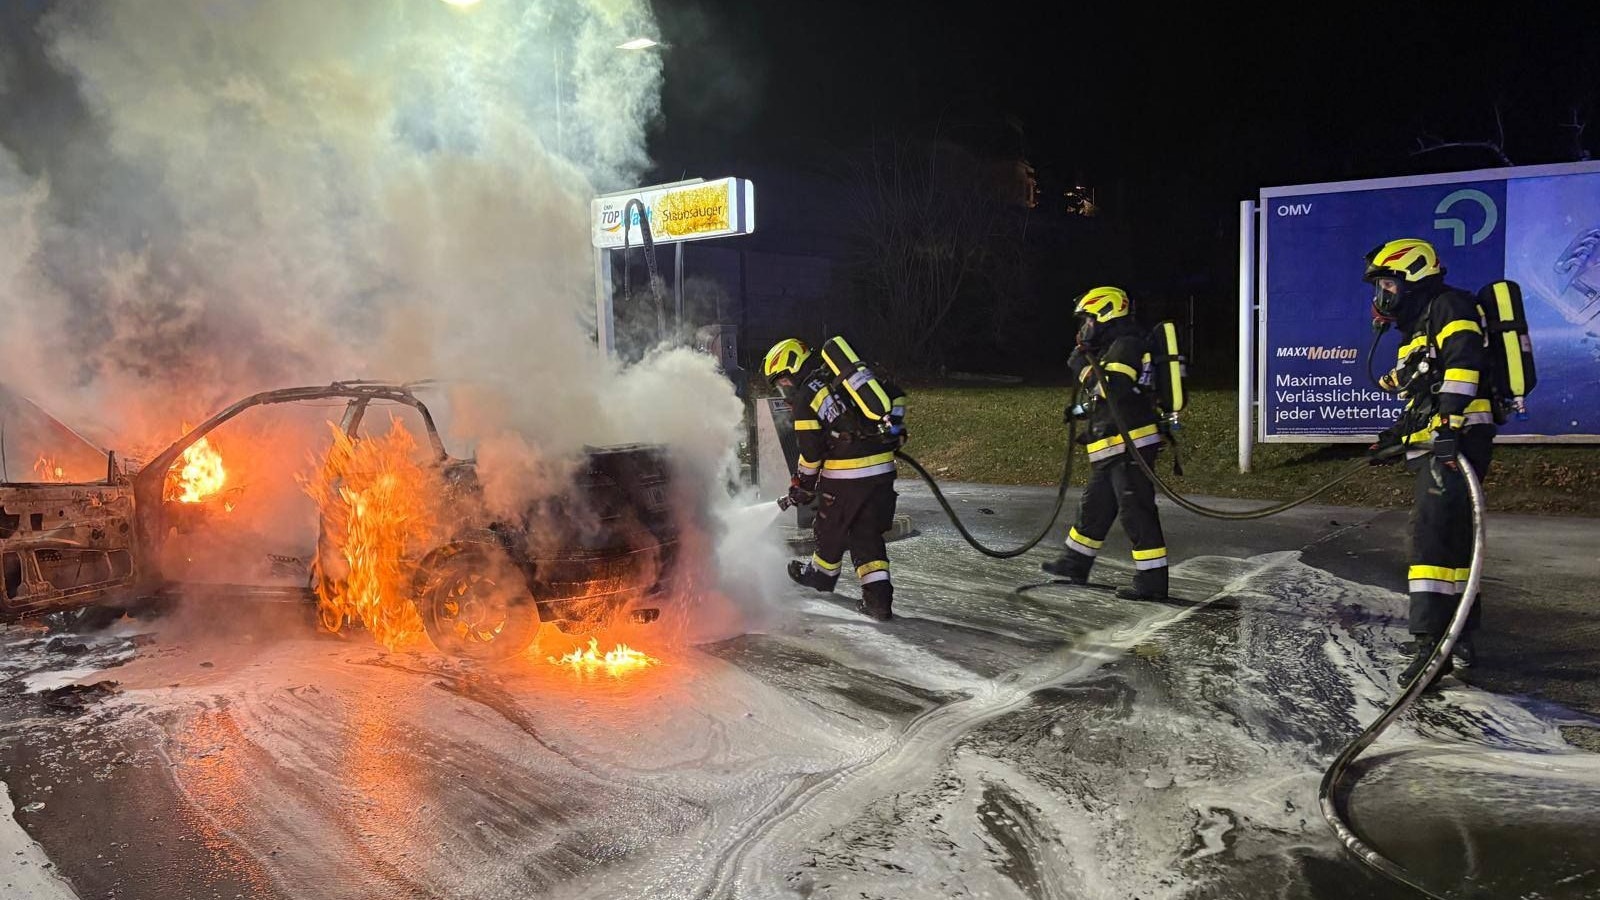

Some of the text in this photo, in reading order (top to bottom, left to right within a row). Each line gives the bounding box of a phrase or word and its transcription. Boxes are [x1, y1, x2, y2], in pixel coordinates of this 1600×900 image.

[662, 206, 723, 222] Staubsauger
[1277, 203, 1312, 217] OMV
[1276, 346, 1358, 360] MAXXMotion
[1276, 373, 1353, 387] Maximale
[1275, 404, 1402, 423] jeder Wetterlag
